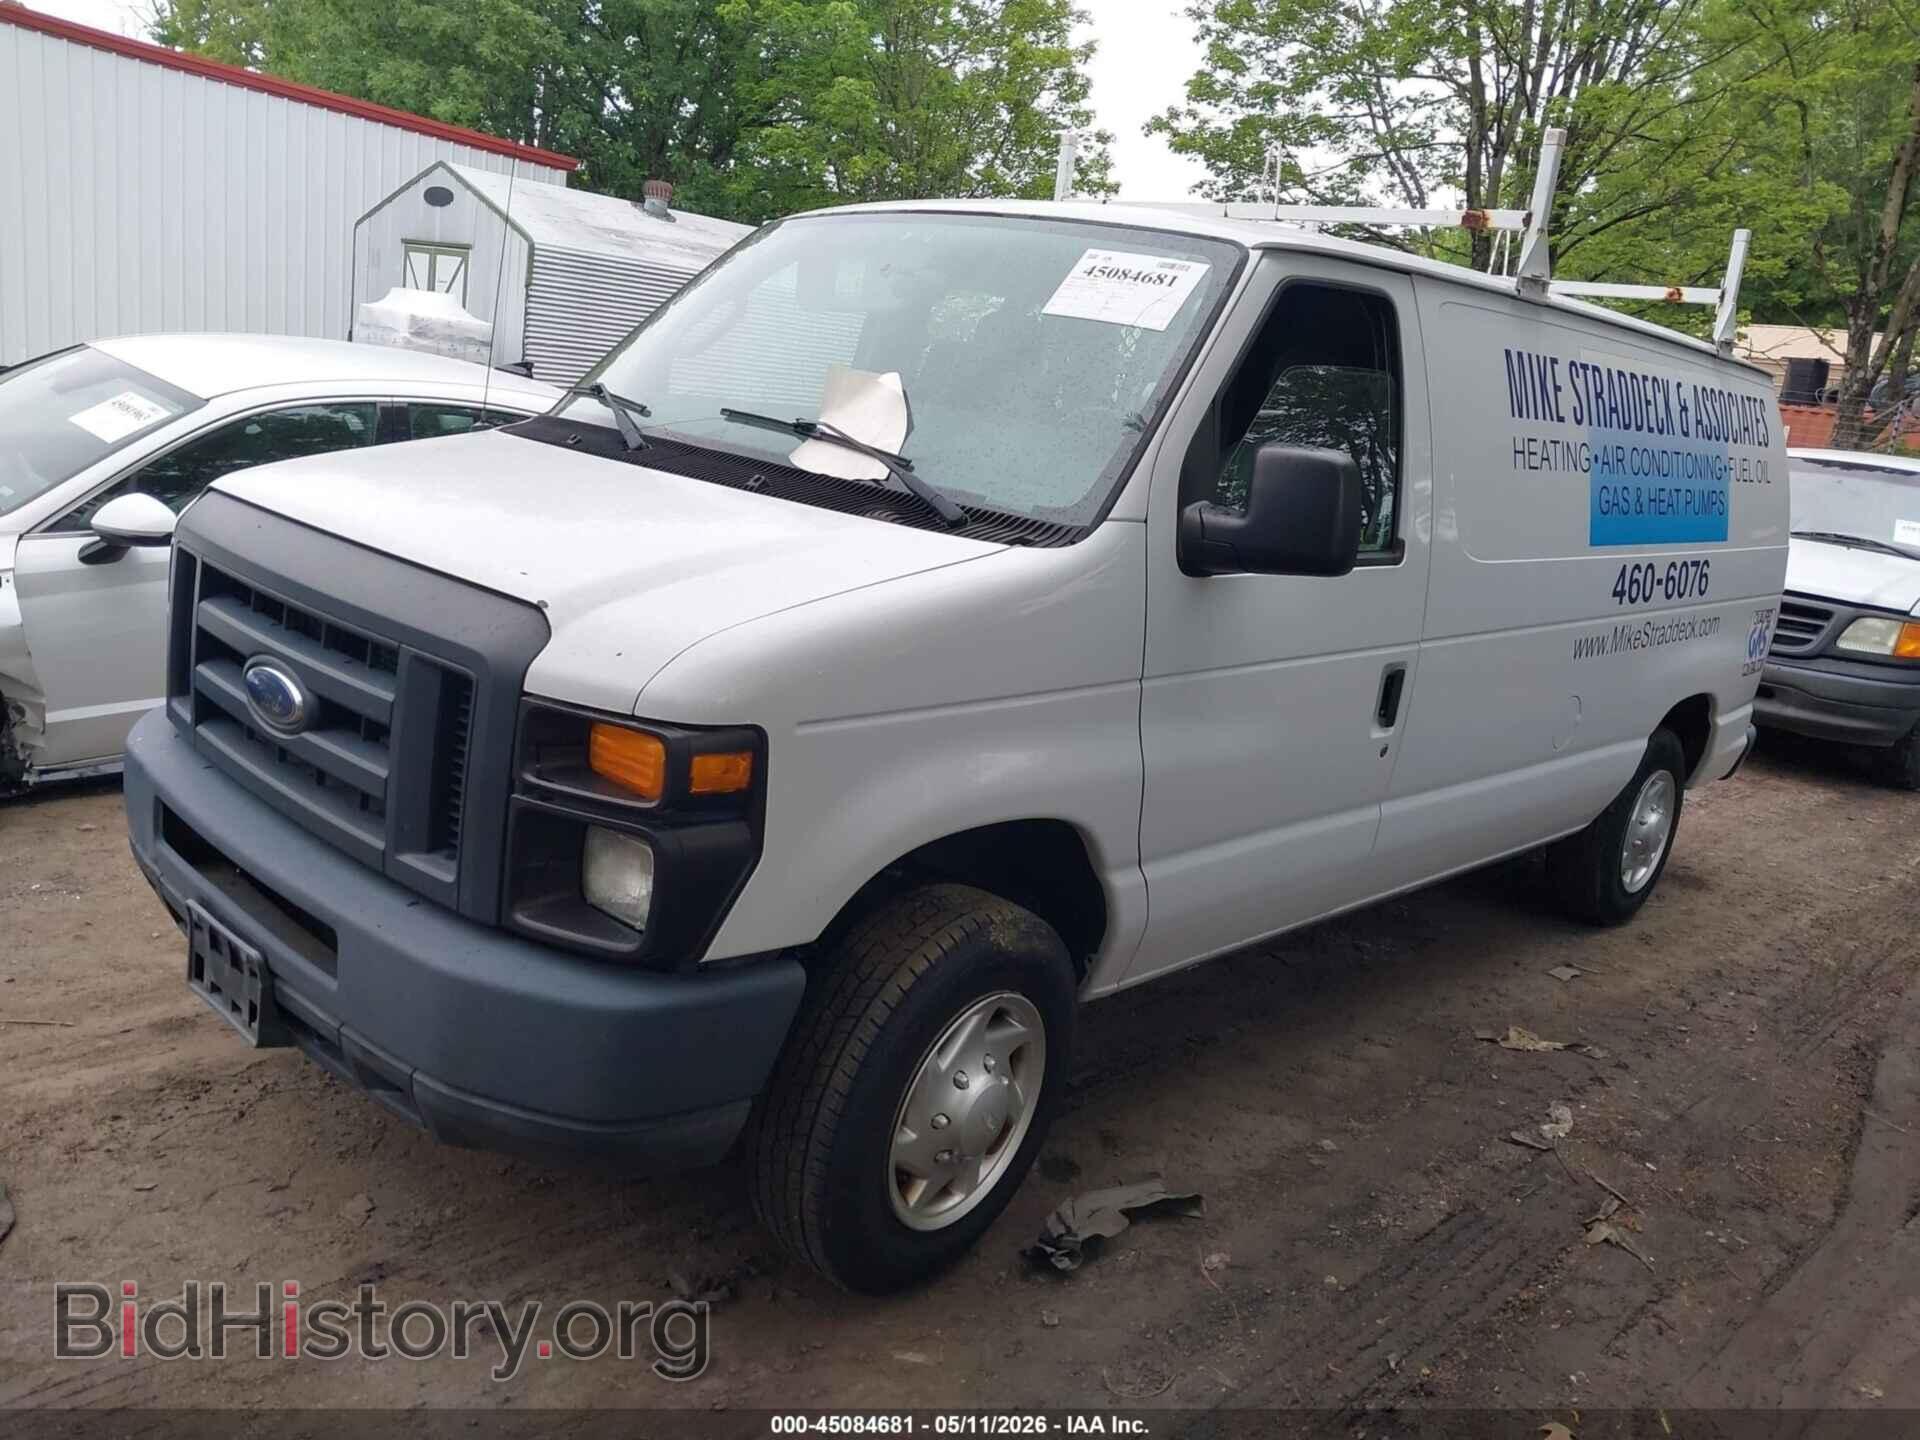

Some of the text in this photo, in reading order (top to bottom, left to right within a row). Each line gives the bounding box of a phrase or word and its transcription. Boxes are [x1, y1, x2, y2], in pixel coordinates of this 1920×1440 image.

[1083, 265, 1178, 287] 45084681
[1504, 349, 1770, 448] MIKE STRADDECK & ASSOCIATES
[1513, 437, 1772, 484] HEATING AIR CONDITIONING FUEL OIL
[1600, 486, 1725, 516] GAS & HEAT PUMPS
[1612, 559, 1710, 605] 460-6076
[1573, 615, 1720, 660] www.MikeStraddeck.com
